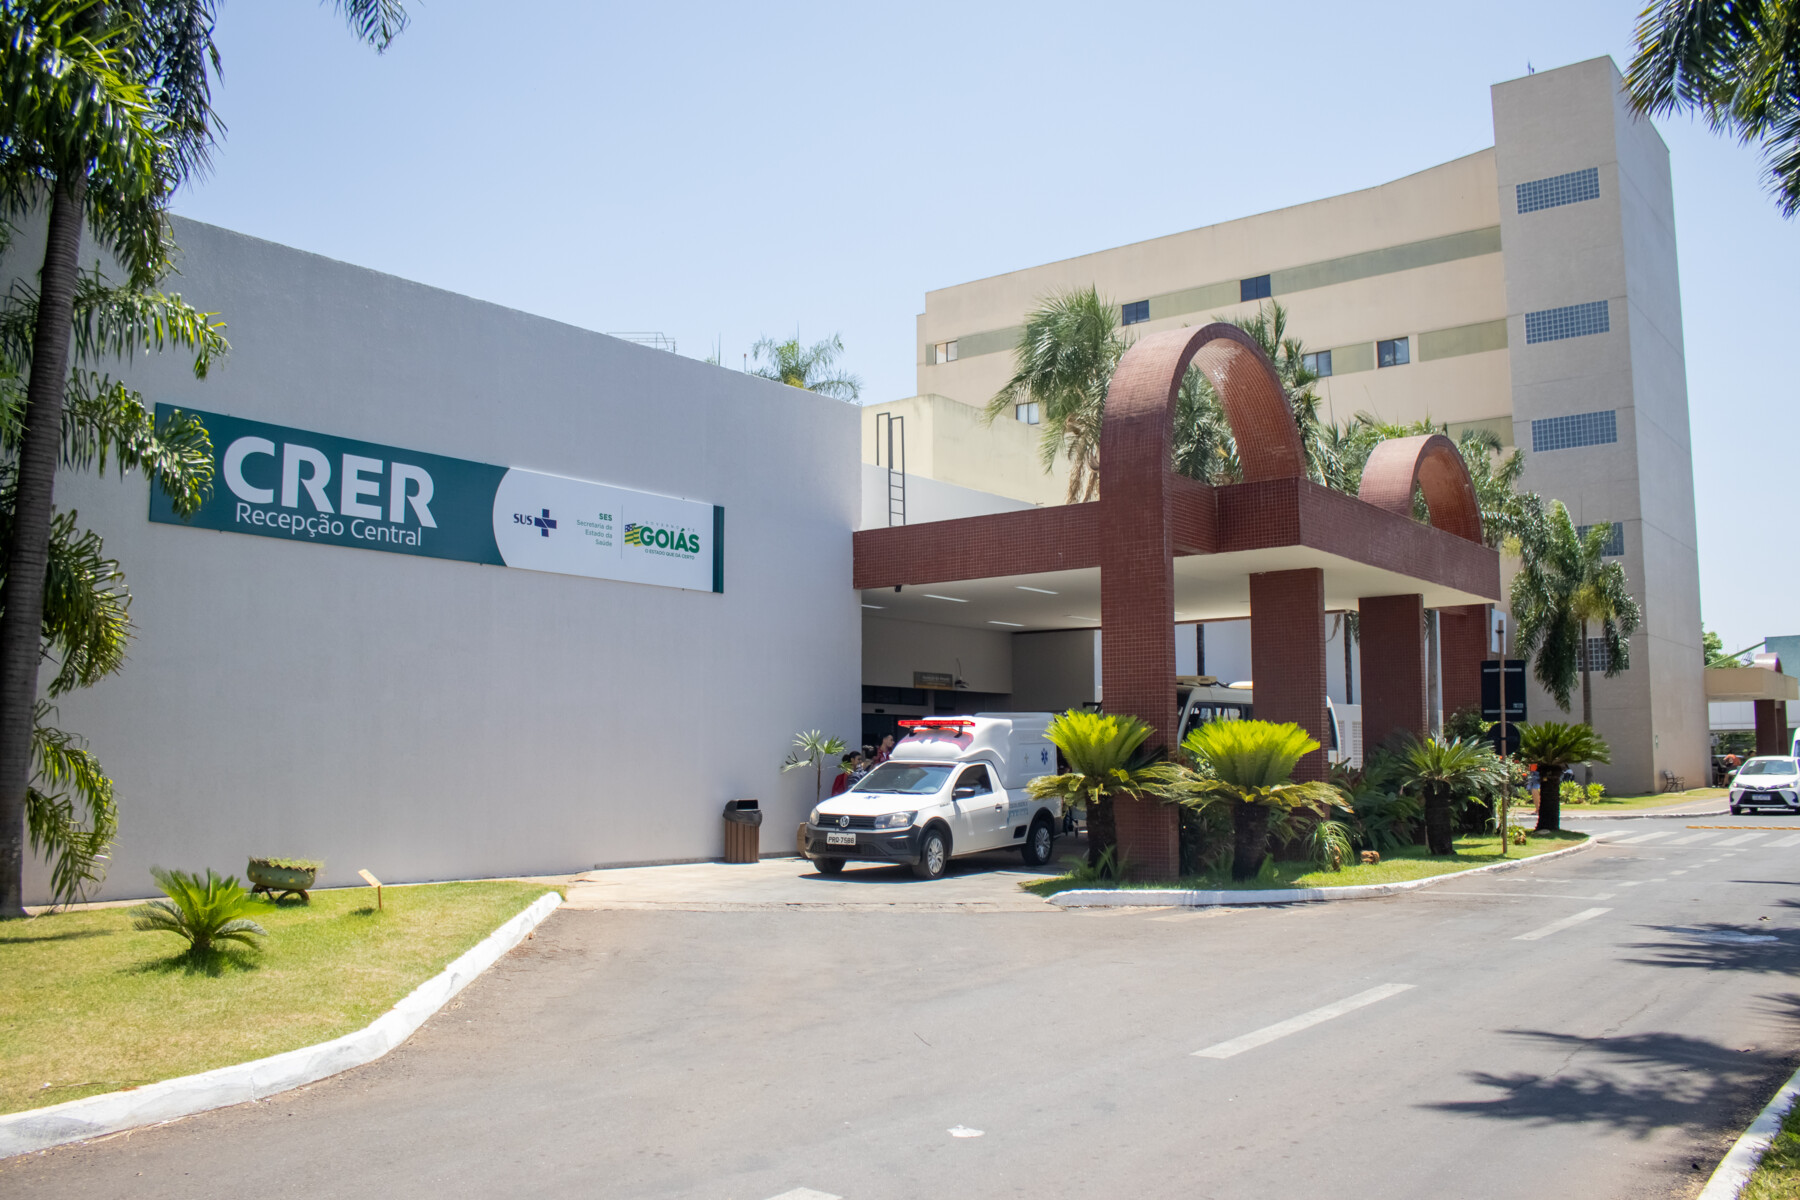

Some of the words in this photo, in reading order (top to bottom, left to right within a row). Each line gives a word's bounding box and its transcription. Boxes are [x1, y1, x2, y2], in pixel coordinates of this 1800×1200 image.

[223, 436, 438, 529] CRER
[513, 513, 533, 526] SUS
[599, 513, 613, 521] SES
[236, 502, 344, 537] Recepção
[351, 519, 422, 546] Central
[576, 519, 604, 530] Secretaria
[585, 529, 604, 538] Estado
[640, 526, 700, 554] GOIÁS
